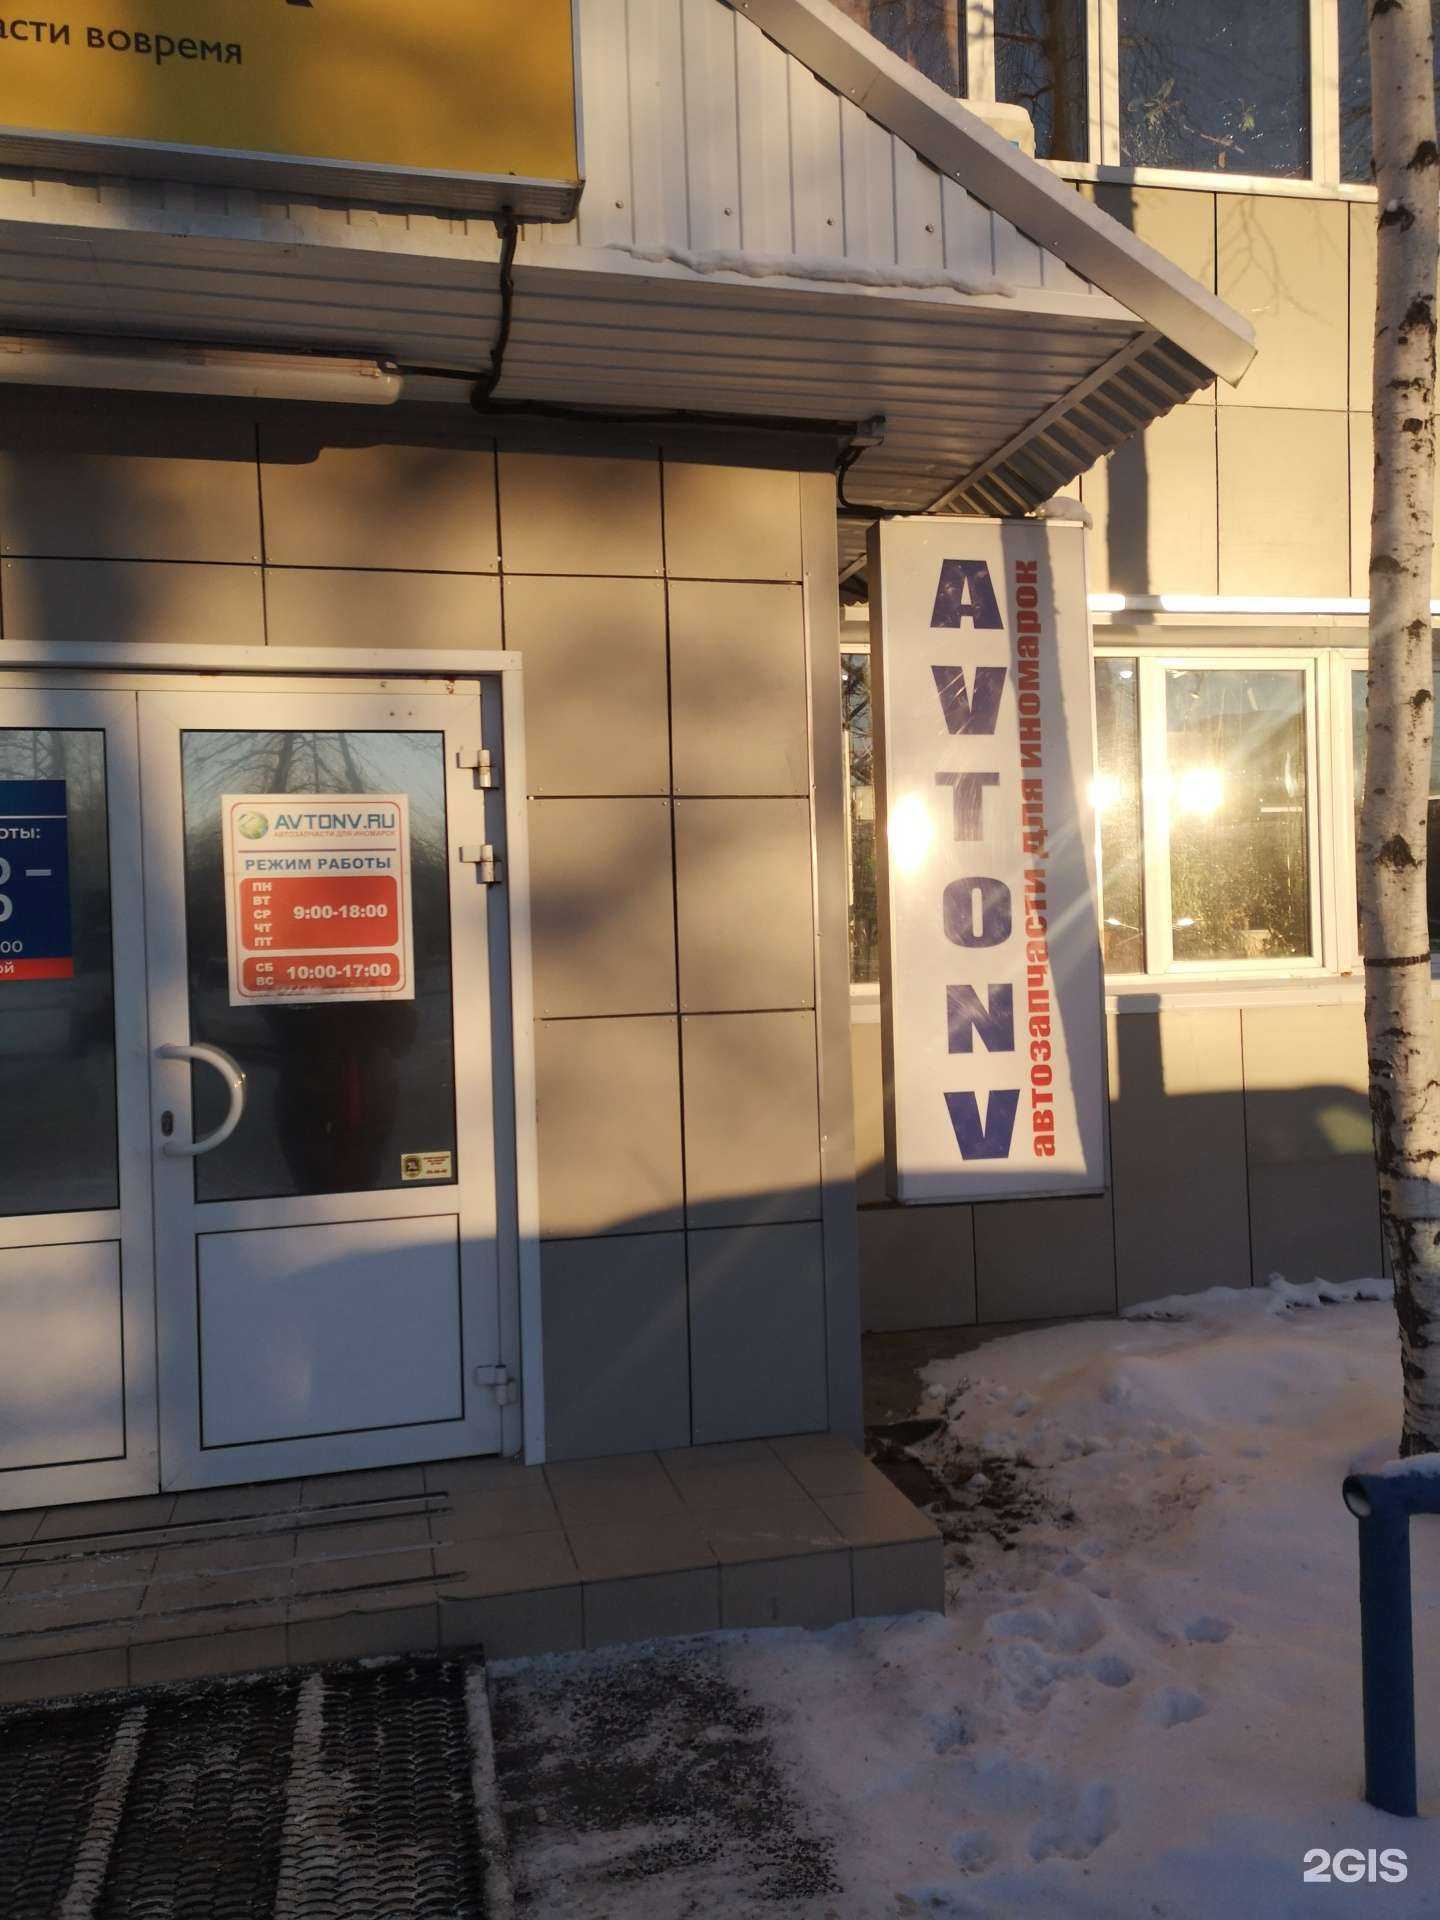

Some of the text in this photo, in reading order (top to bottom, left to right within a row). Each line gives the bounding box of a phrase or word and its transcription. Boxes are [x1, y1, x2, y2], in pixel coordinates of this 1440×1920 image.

[86, 29, 243, 65] вовремя
[274, 813, 396, 830] AVTONV.RU
[245, 856, 392, 872] РЕЖИМ РАБОТЫ
[929, 558, 1021, 1161] AVTONV
[1015, 559, 1056, 1159] автозапчасти для иномарок
[252, 882, 273, 892] ПН
[253, 896, 271, 906] ВТ
[253, 909, 272, 920] СР
[293, 903, 388, 920] 9:00-18:00
[254, 923, 272, 933] ЧТ
[254, 936, 273, 947] ПТ
[256, 963, 273, 973] СБ
[287, 963, 392, 980] 10:00-17:00
[256, 976, 274, 986] ВС
